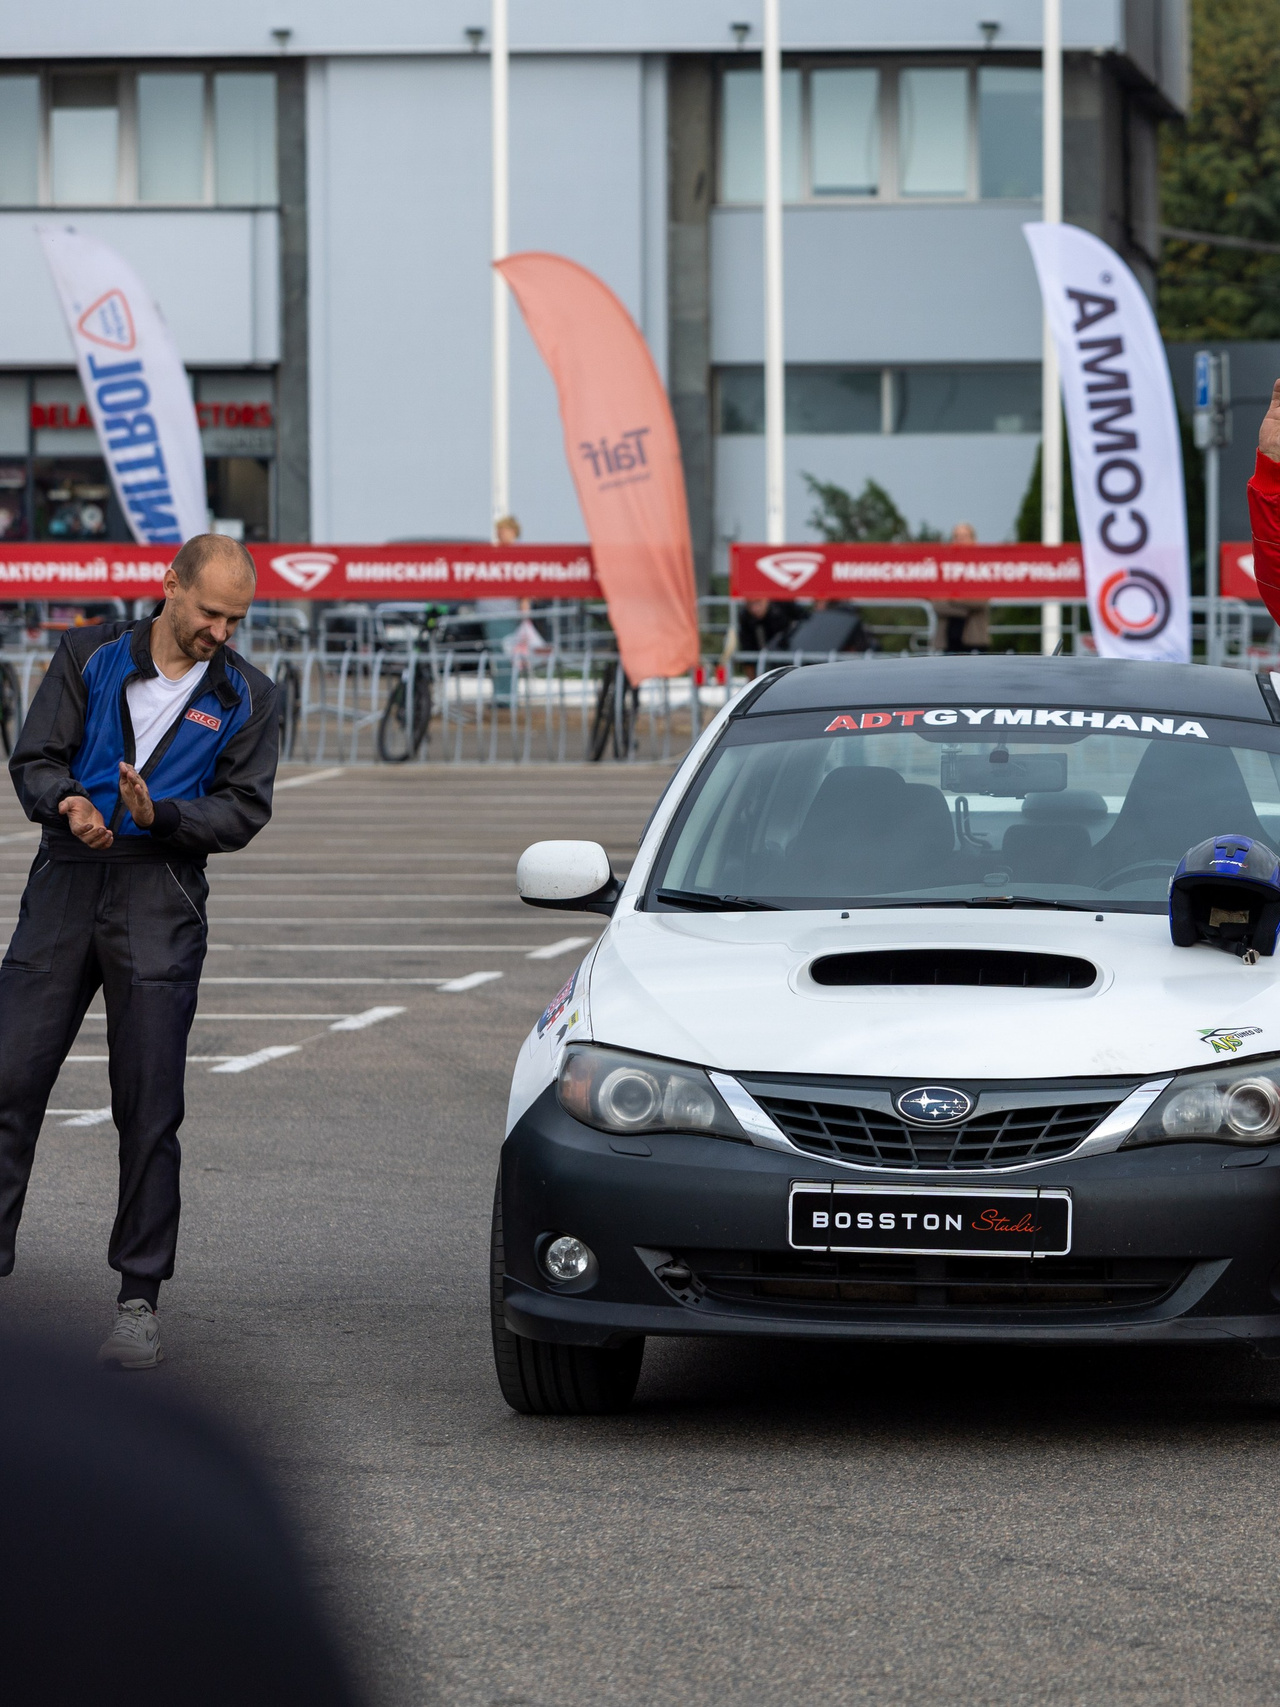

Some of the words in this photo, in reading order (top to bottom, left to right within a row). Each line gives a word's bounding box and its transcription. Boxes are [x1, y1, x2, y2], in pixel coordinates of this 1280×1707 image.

[31, 404, 95, 429] BELA
[0, 558, 107, 582] АКТОРНЫЙ
[111, 562, 170, 582] ЗАВО
[346, 558, 448, 581] МИНСКИЙ
[452, 558, 590, 581] ТРАКТОРНЫЙ
[832, 558, 938, 581] МИНСКИЙ
[942, 558, 1081, 581] ТРАКТОРНЫЙ
[190, 711, 217, 727] RLG
[824, 709, 1209, 738] ADTGYMKHANA
[812, 1211, 962, 1231] BOSSTON
